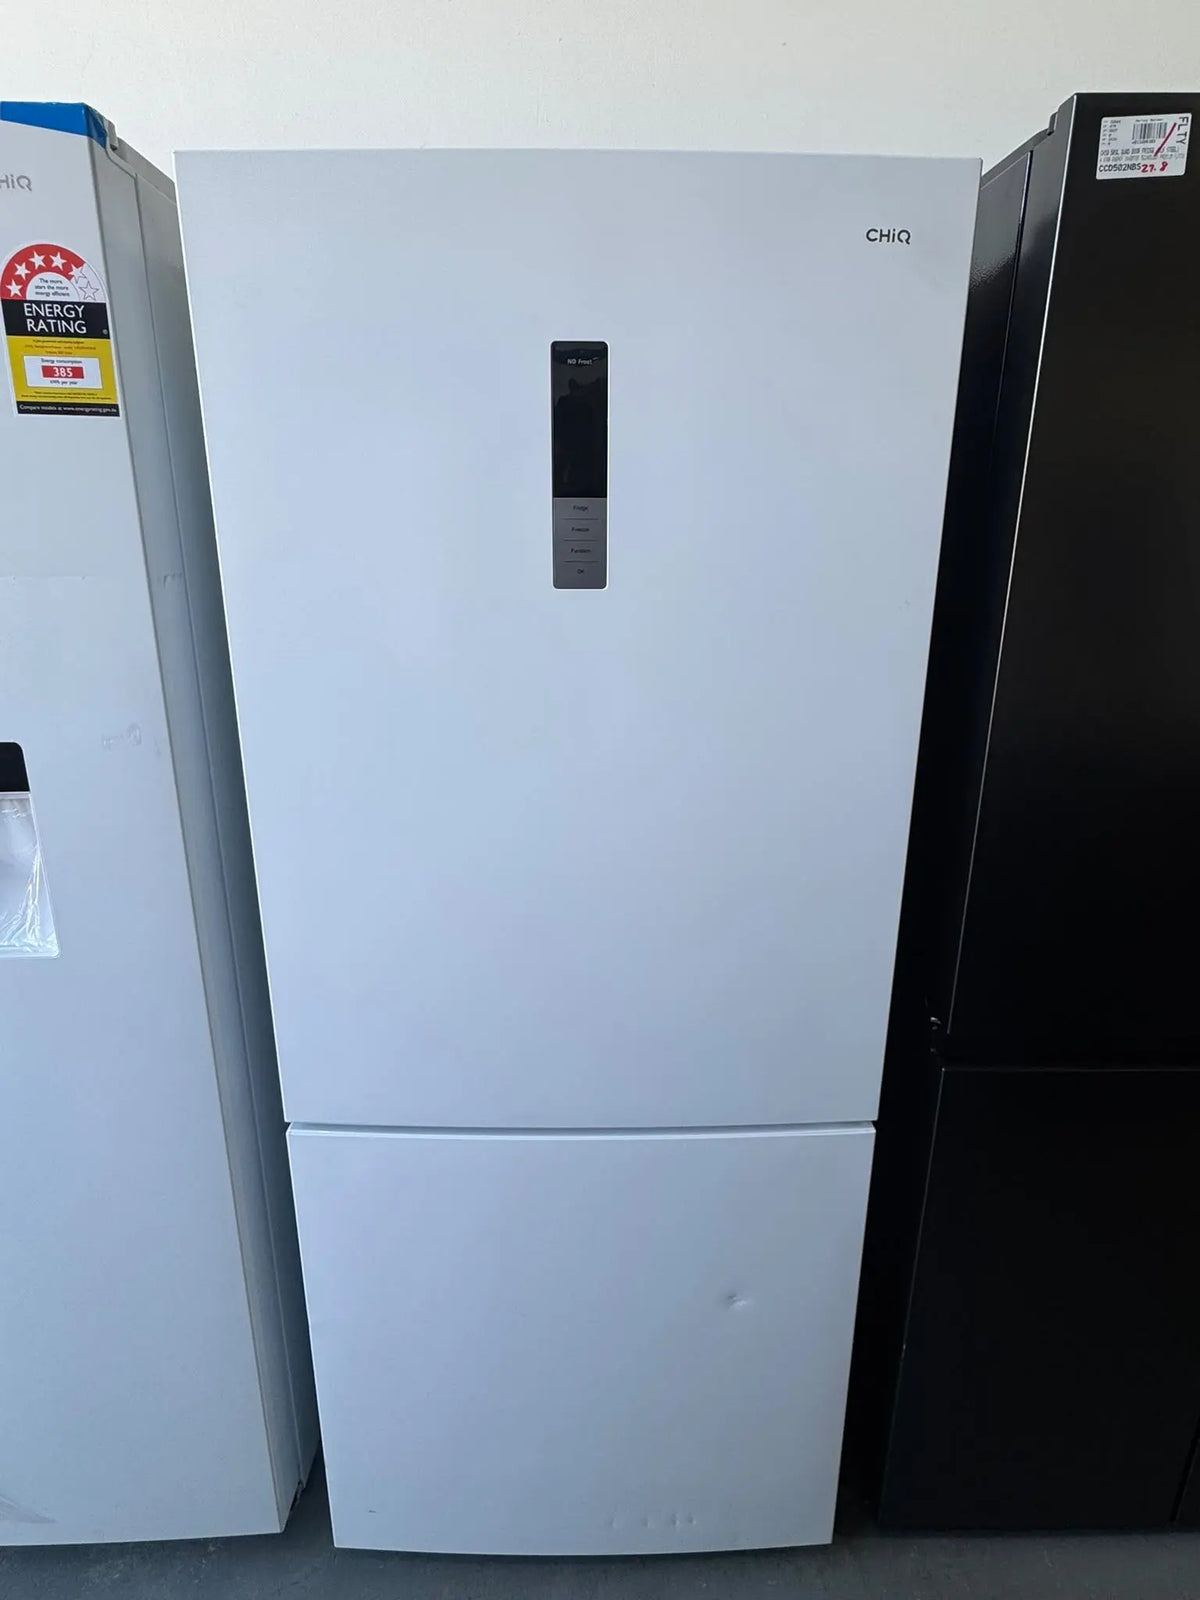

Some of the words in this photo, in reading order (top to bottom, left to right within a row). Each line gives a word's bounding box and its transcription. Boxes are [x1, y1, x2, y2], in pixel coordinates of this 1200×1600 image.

[1176, 116, 1189, 145] FLTY
[1098, 162, 1141, 172] CCD502NBS
[866, 228, 911, 245] CHiQ
[23, 303, 85, 318] ENERGY
[26, 319, 87, 334] RATING
[53, 367, 73, 377] 385
